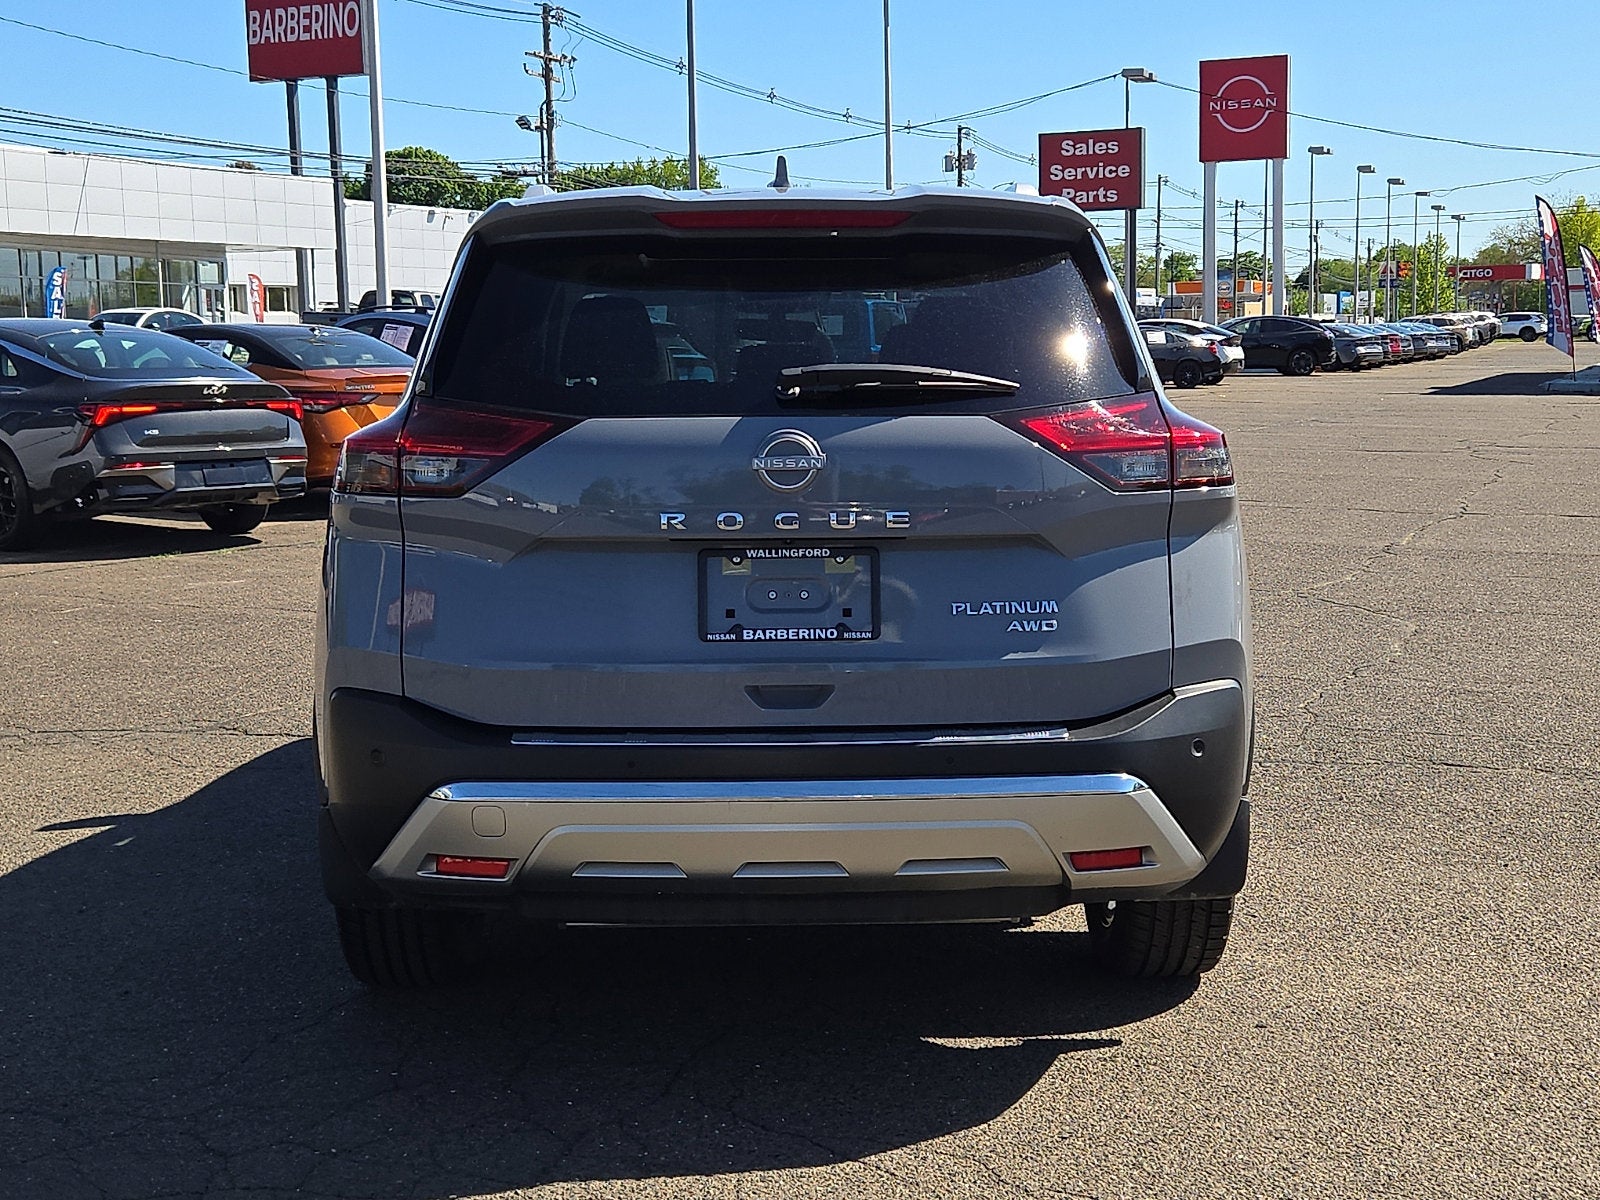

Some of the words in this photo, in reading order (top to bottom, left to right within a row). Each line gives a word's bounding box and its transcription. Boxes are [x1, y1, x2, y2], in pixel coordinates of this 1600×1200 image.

[248, 1, 360, 45] BARBERINO
[1209, 97, 1278, 111] NISSAN
[1061, 138, 1119, 157] Sales
[1049, 162, 1131, 181] Service
[1061, 187, 1118, 204] Parts
[1459, 268, 1493, 278] CITGO
[754, 459, 821, 468] NISSAN
[659, 511, 911, 531] ROGUE
[746, 548, 830, 558] WALLINGFORD
[951, 600, 1059, 615] PLATINUM
[1006, 619, 1058, 632] AWD
[707, 633, 736, 641] NISSAN
[743, 628, 838, 640] BARBERINO
[843, 631, 872, 639] NISSAN
